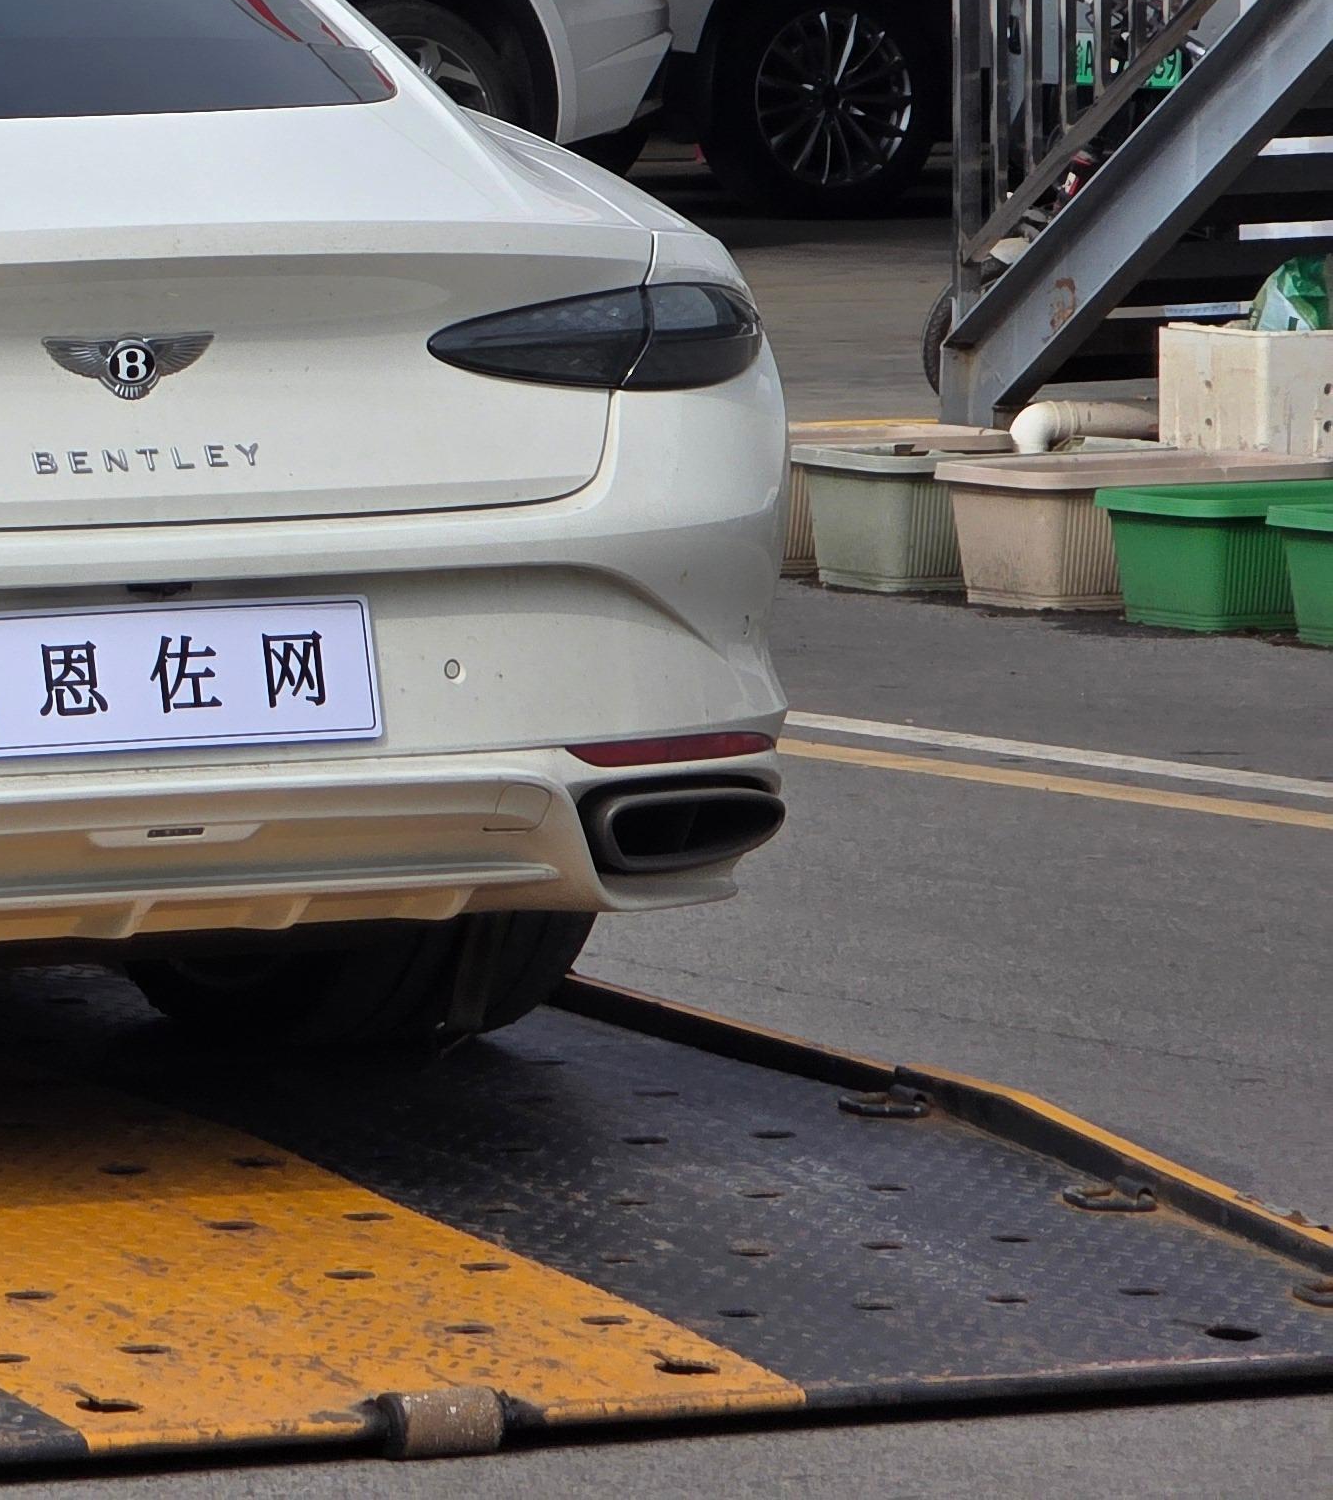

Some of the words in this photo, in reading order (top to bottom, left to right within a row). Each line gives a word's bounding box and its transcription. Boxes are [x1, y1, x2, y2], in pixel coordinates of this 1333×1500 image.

[116, 348, 149, 381] B
[31, 442, 261, 475] BENTLEY
[39, 630, 328, 717] 恩佐网
